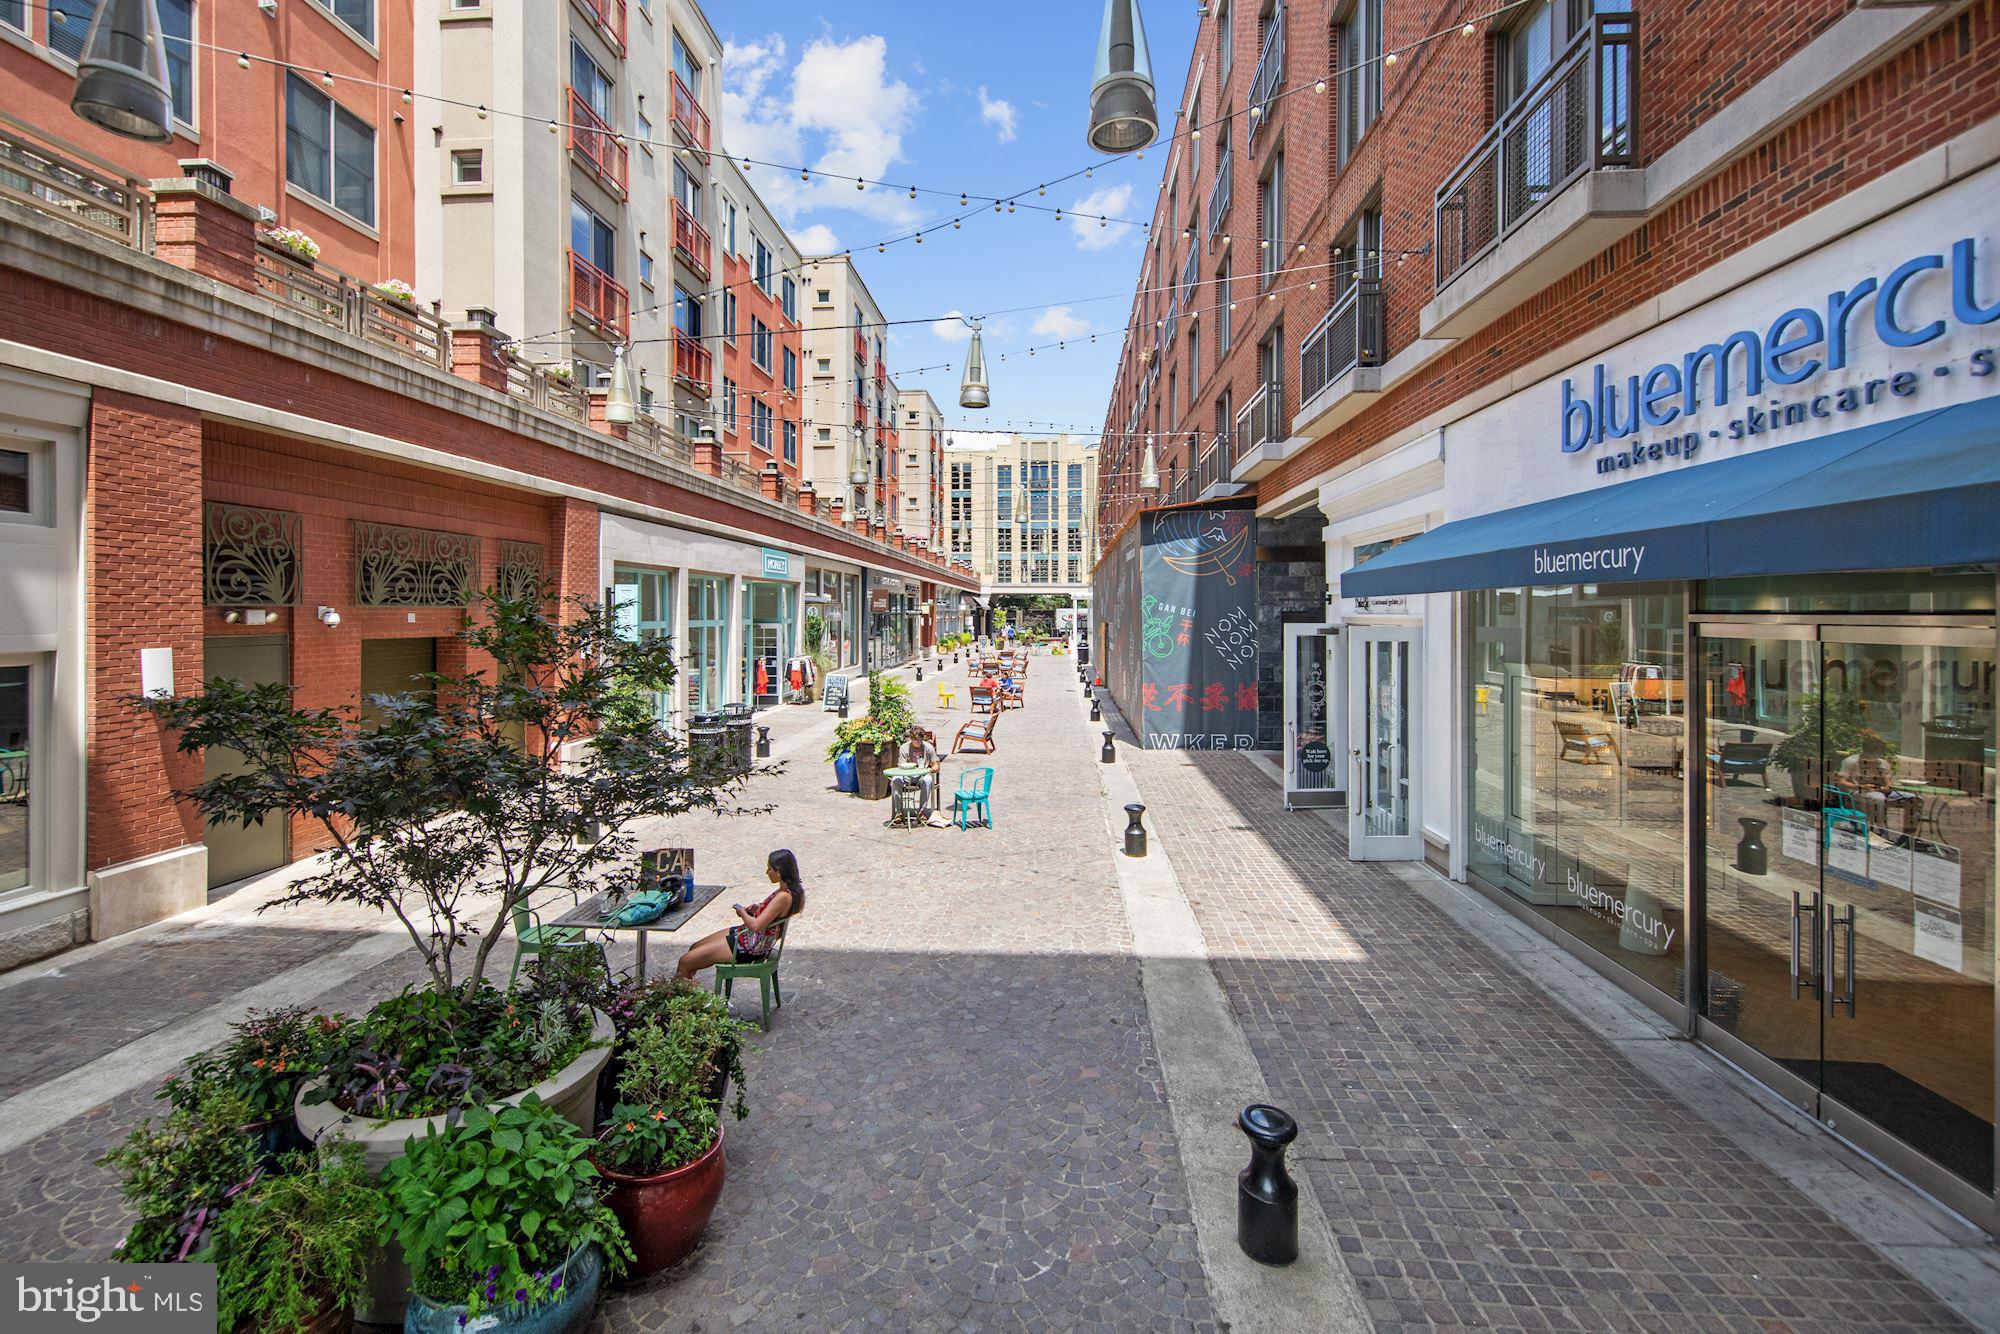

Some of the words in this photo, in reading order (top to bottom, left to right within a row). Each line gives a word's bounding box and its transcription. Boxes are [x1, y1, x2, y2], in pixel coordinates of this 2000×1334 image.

[1562, 238, 2000, 454] bluemercu
[1597, 432, 1700, 474] makeup
[1728, 371, 1916, 439] skincare
[1535, 546, 1645, 574] bluemercury
[1158, 602, 1176, 613] GAN
[1180, 607, 1196, 617] BEI
[1204, 606, 1246, 644] NOM
[1216, 619, 1258, 657] NOM
[1475, 822, 1545, 879] bluemercury
[1567, 868, 1675, 950] bluemercury
[1576, 901, 1601, 919] makeup
[1607, 916, 1638, 939] skincare
[1644, 939, 1658, 950] spa
